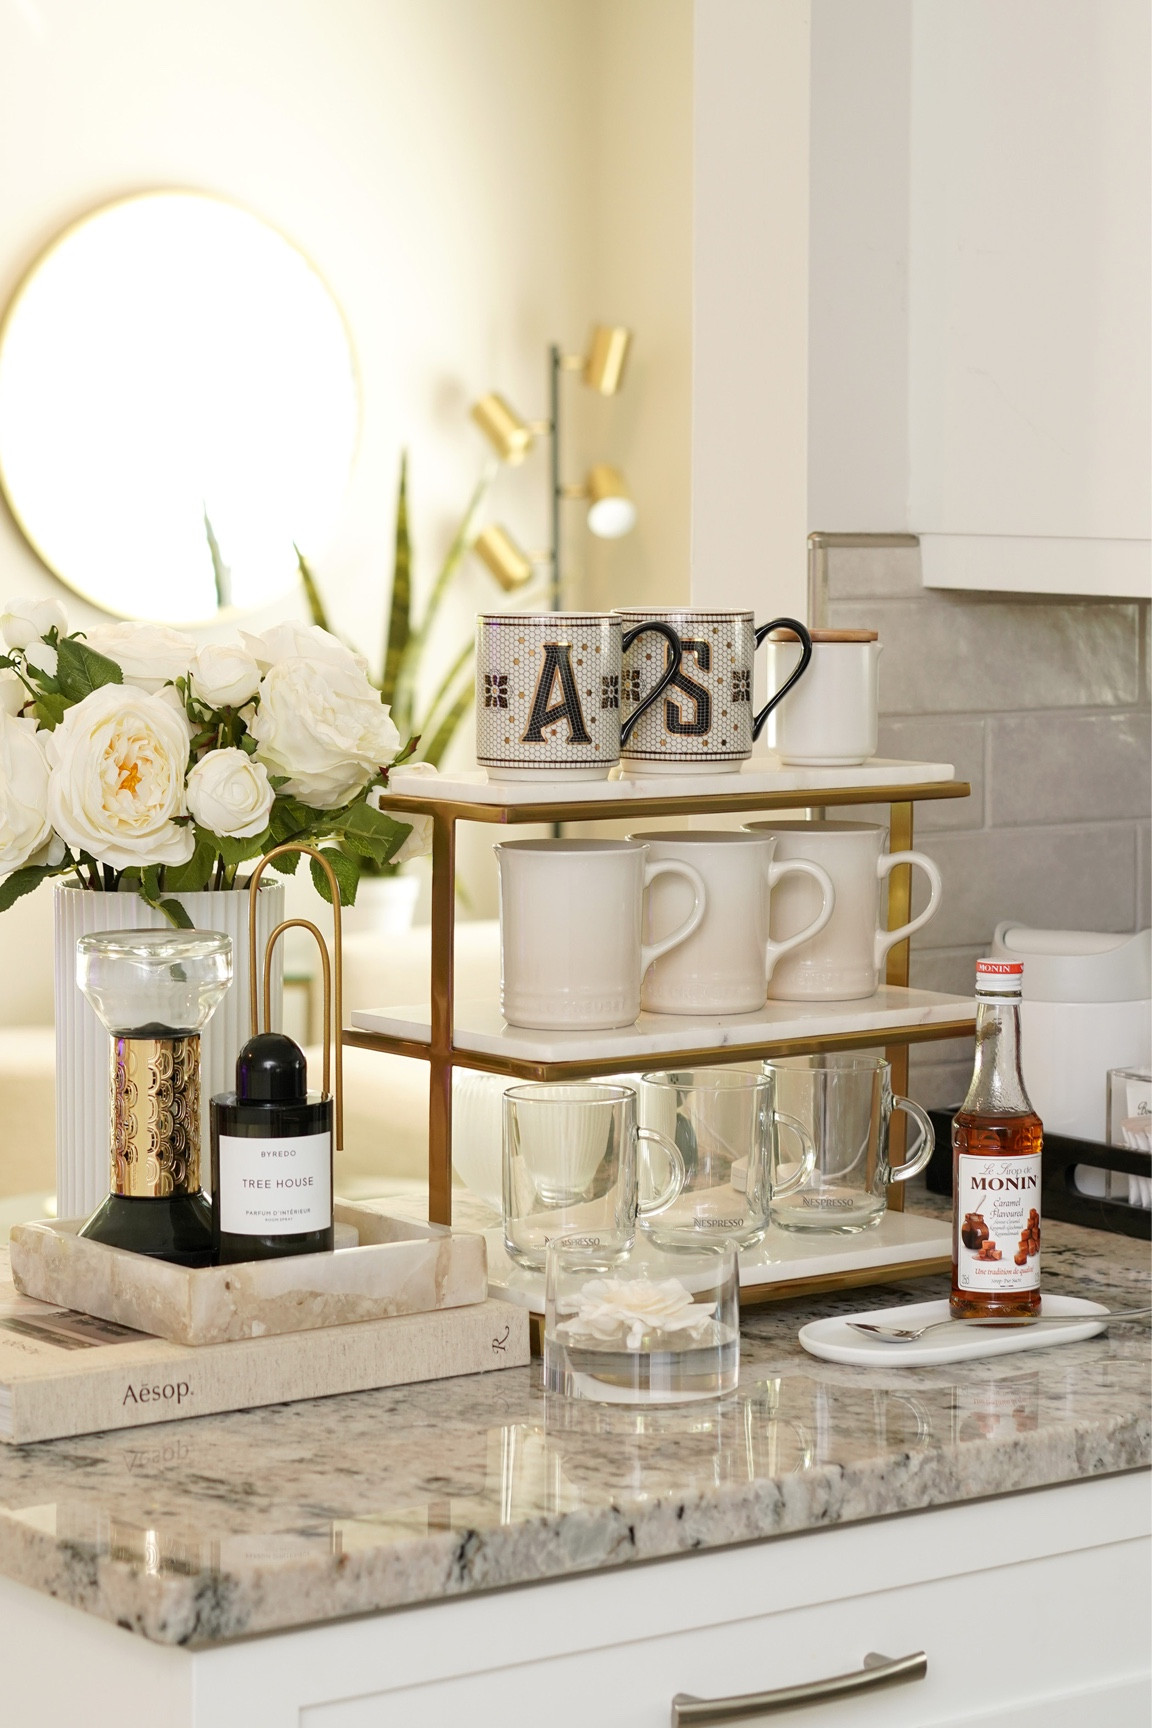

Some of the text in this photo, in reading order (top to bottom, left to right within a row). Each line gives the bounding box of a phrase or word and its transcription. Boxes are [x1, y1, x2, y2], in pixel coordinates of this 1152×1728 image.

[663, 637, 713, 737] S
[518, 641, 593, 745] A
[978, 964, 1010, 973] MONIN
[260, 1150, 297, 1158] BYREDO
[979, 1163, 995, 1175] Le
[1023, 1165, 1033, 1174] de
[242, 1176, 314, 1189] TREE HOUSE
[970, 1174, 1038, 1191] MONIN
[802, 1196, 854, 1207] NESPRESSO
[993, 1197, 1021, 1208] Caramel
[989, 1208, 1024, 1220] Flavoured
[693, 1217, 744, 1228] NESPRESSO
[987, 1267, 1012, 1275] tradition
